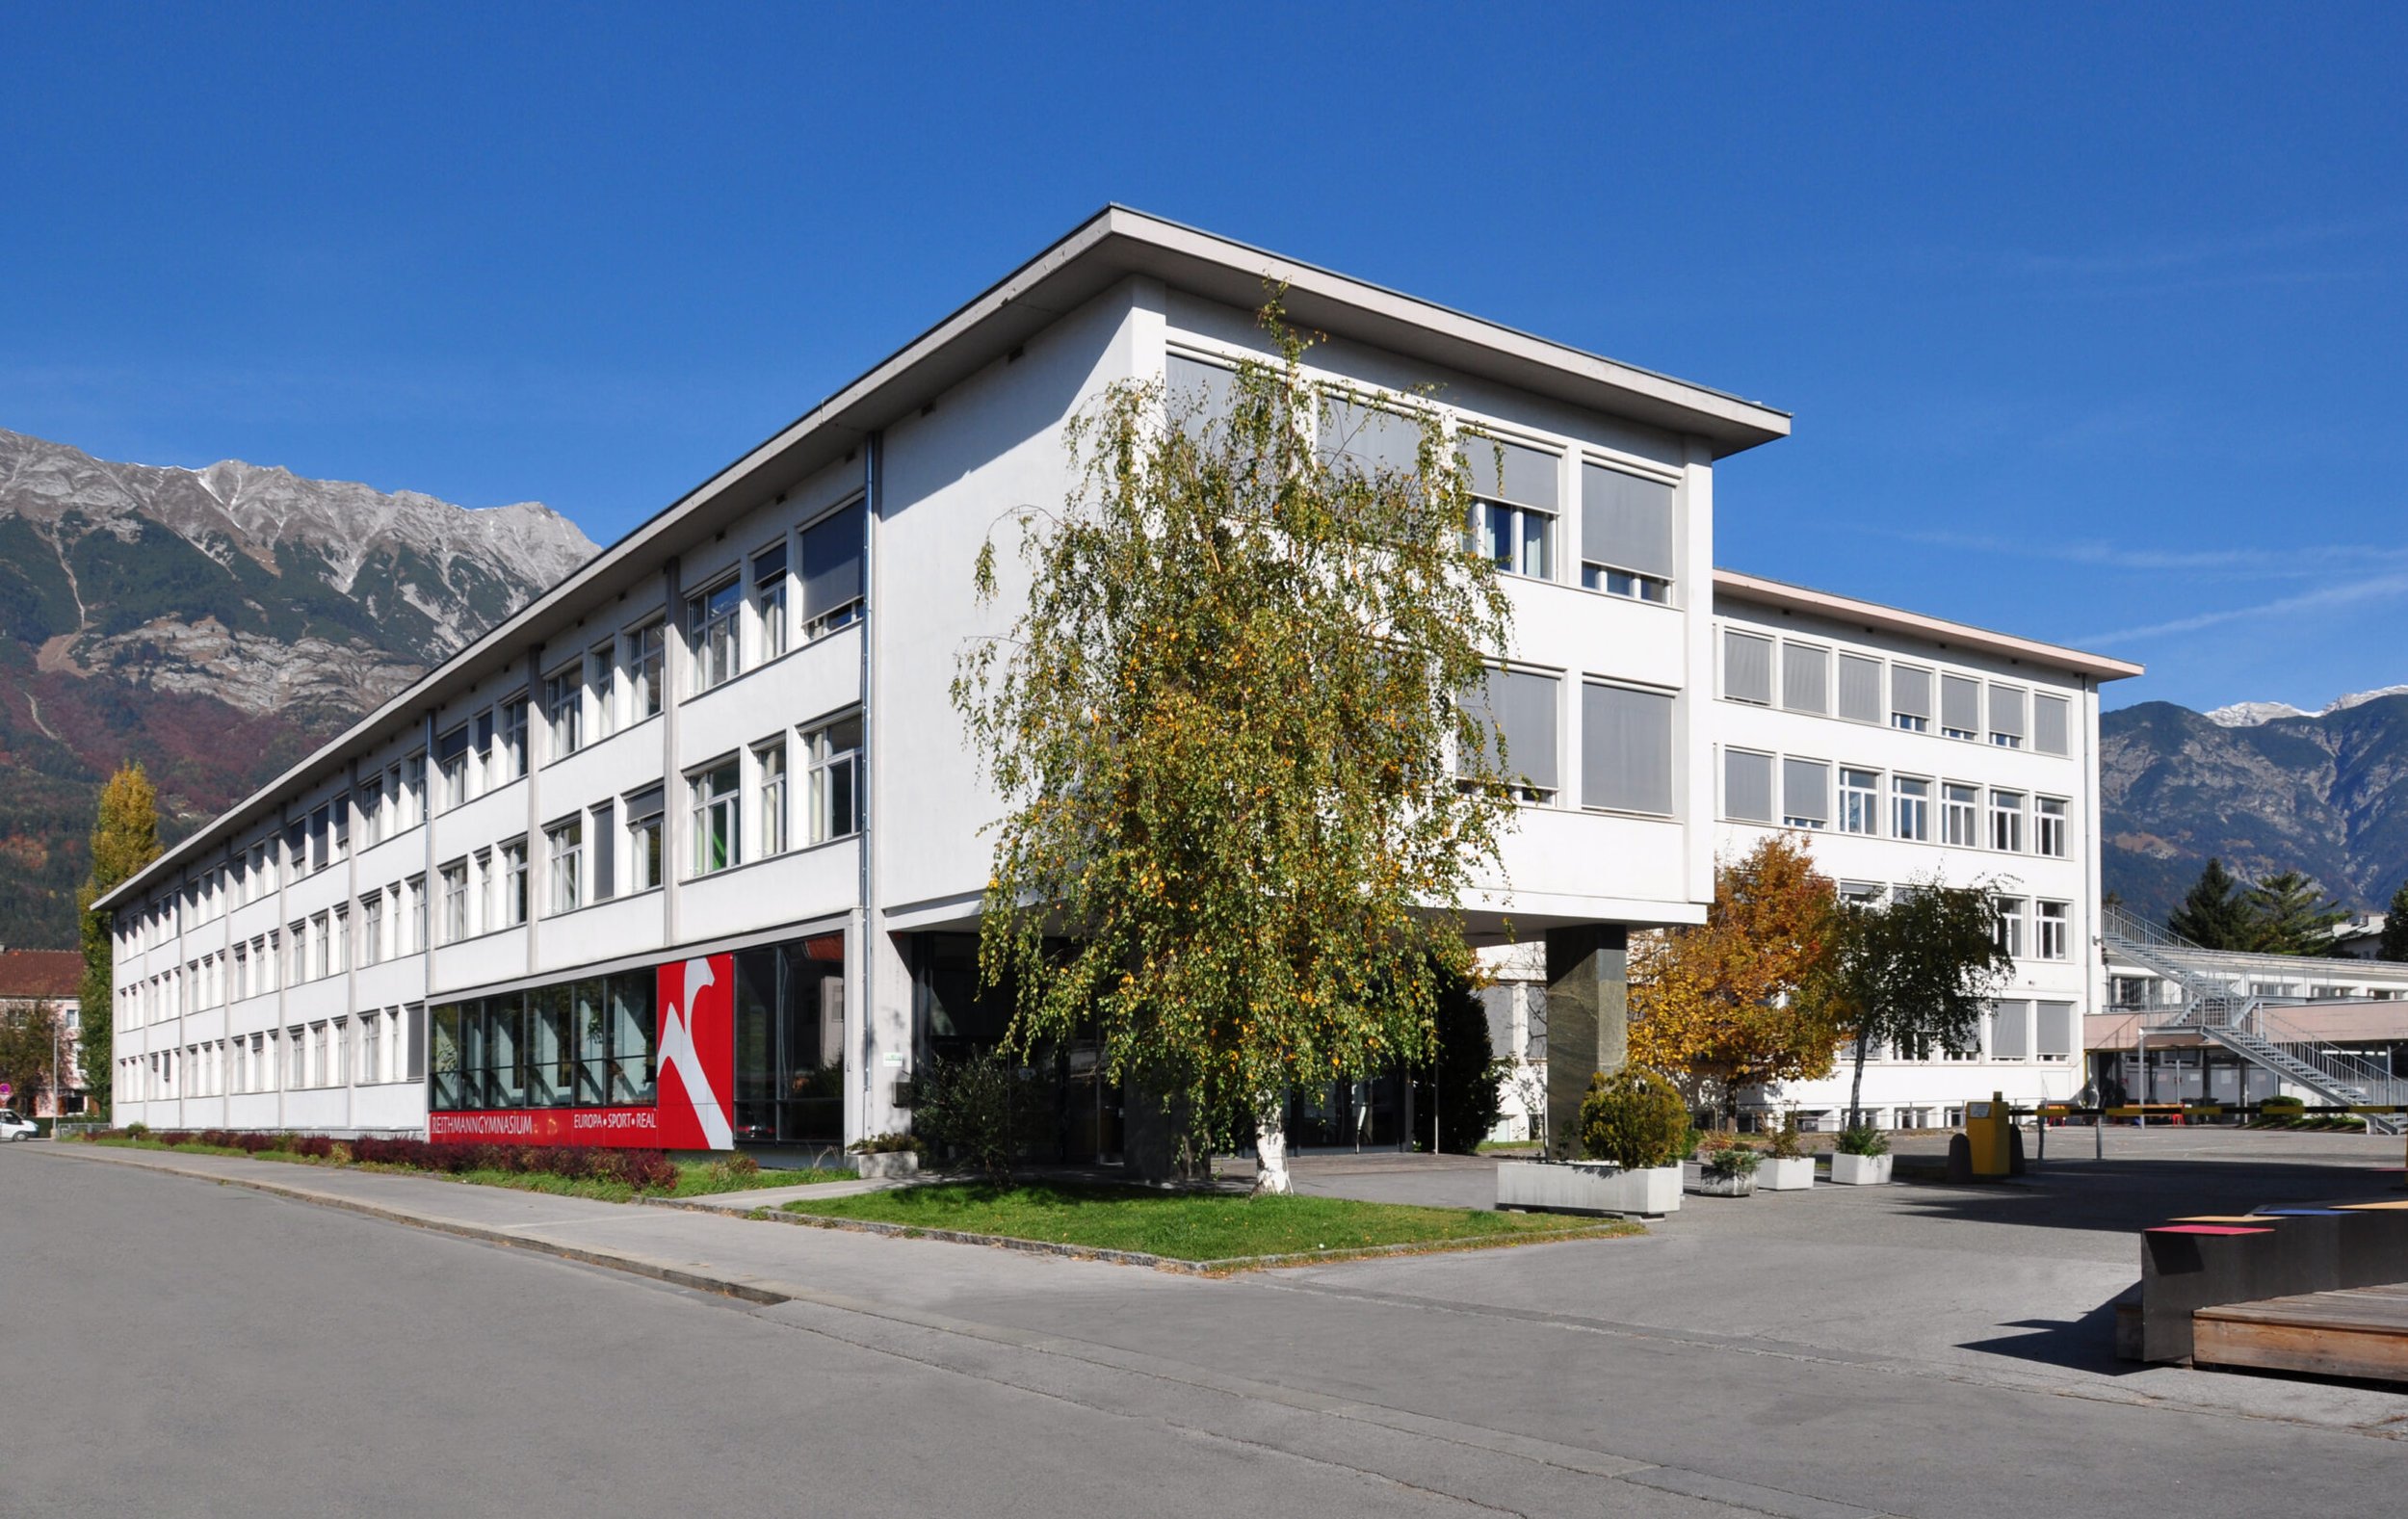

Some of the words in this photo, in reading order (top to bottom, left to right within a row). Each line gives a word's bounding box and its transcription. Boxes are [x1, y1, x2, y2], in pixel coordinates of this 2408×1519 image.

[432, 1115, 533, 1134] REITHMANNGYMNASIUM
[574, 1113, 603, 1128] EUROPA
[608, 1113, 632, 1128] SPORT
[636, 1113, 657, 1128] REAL
